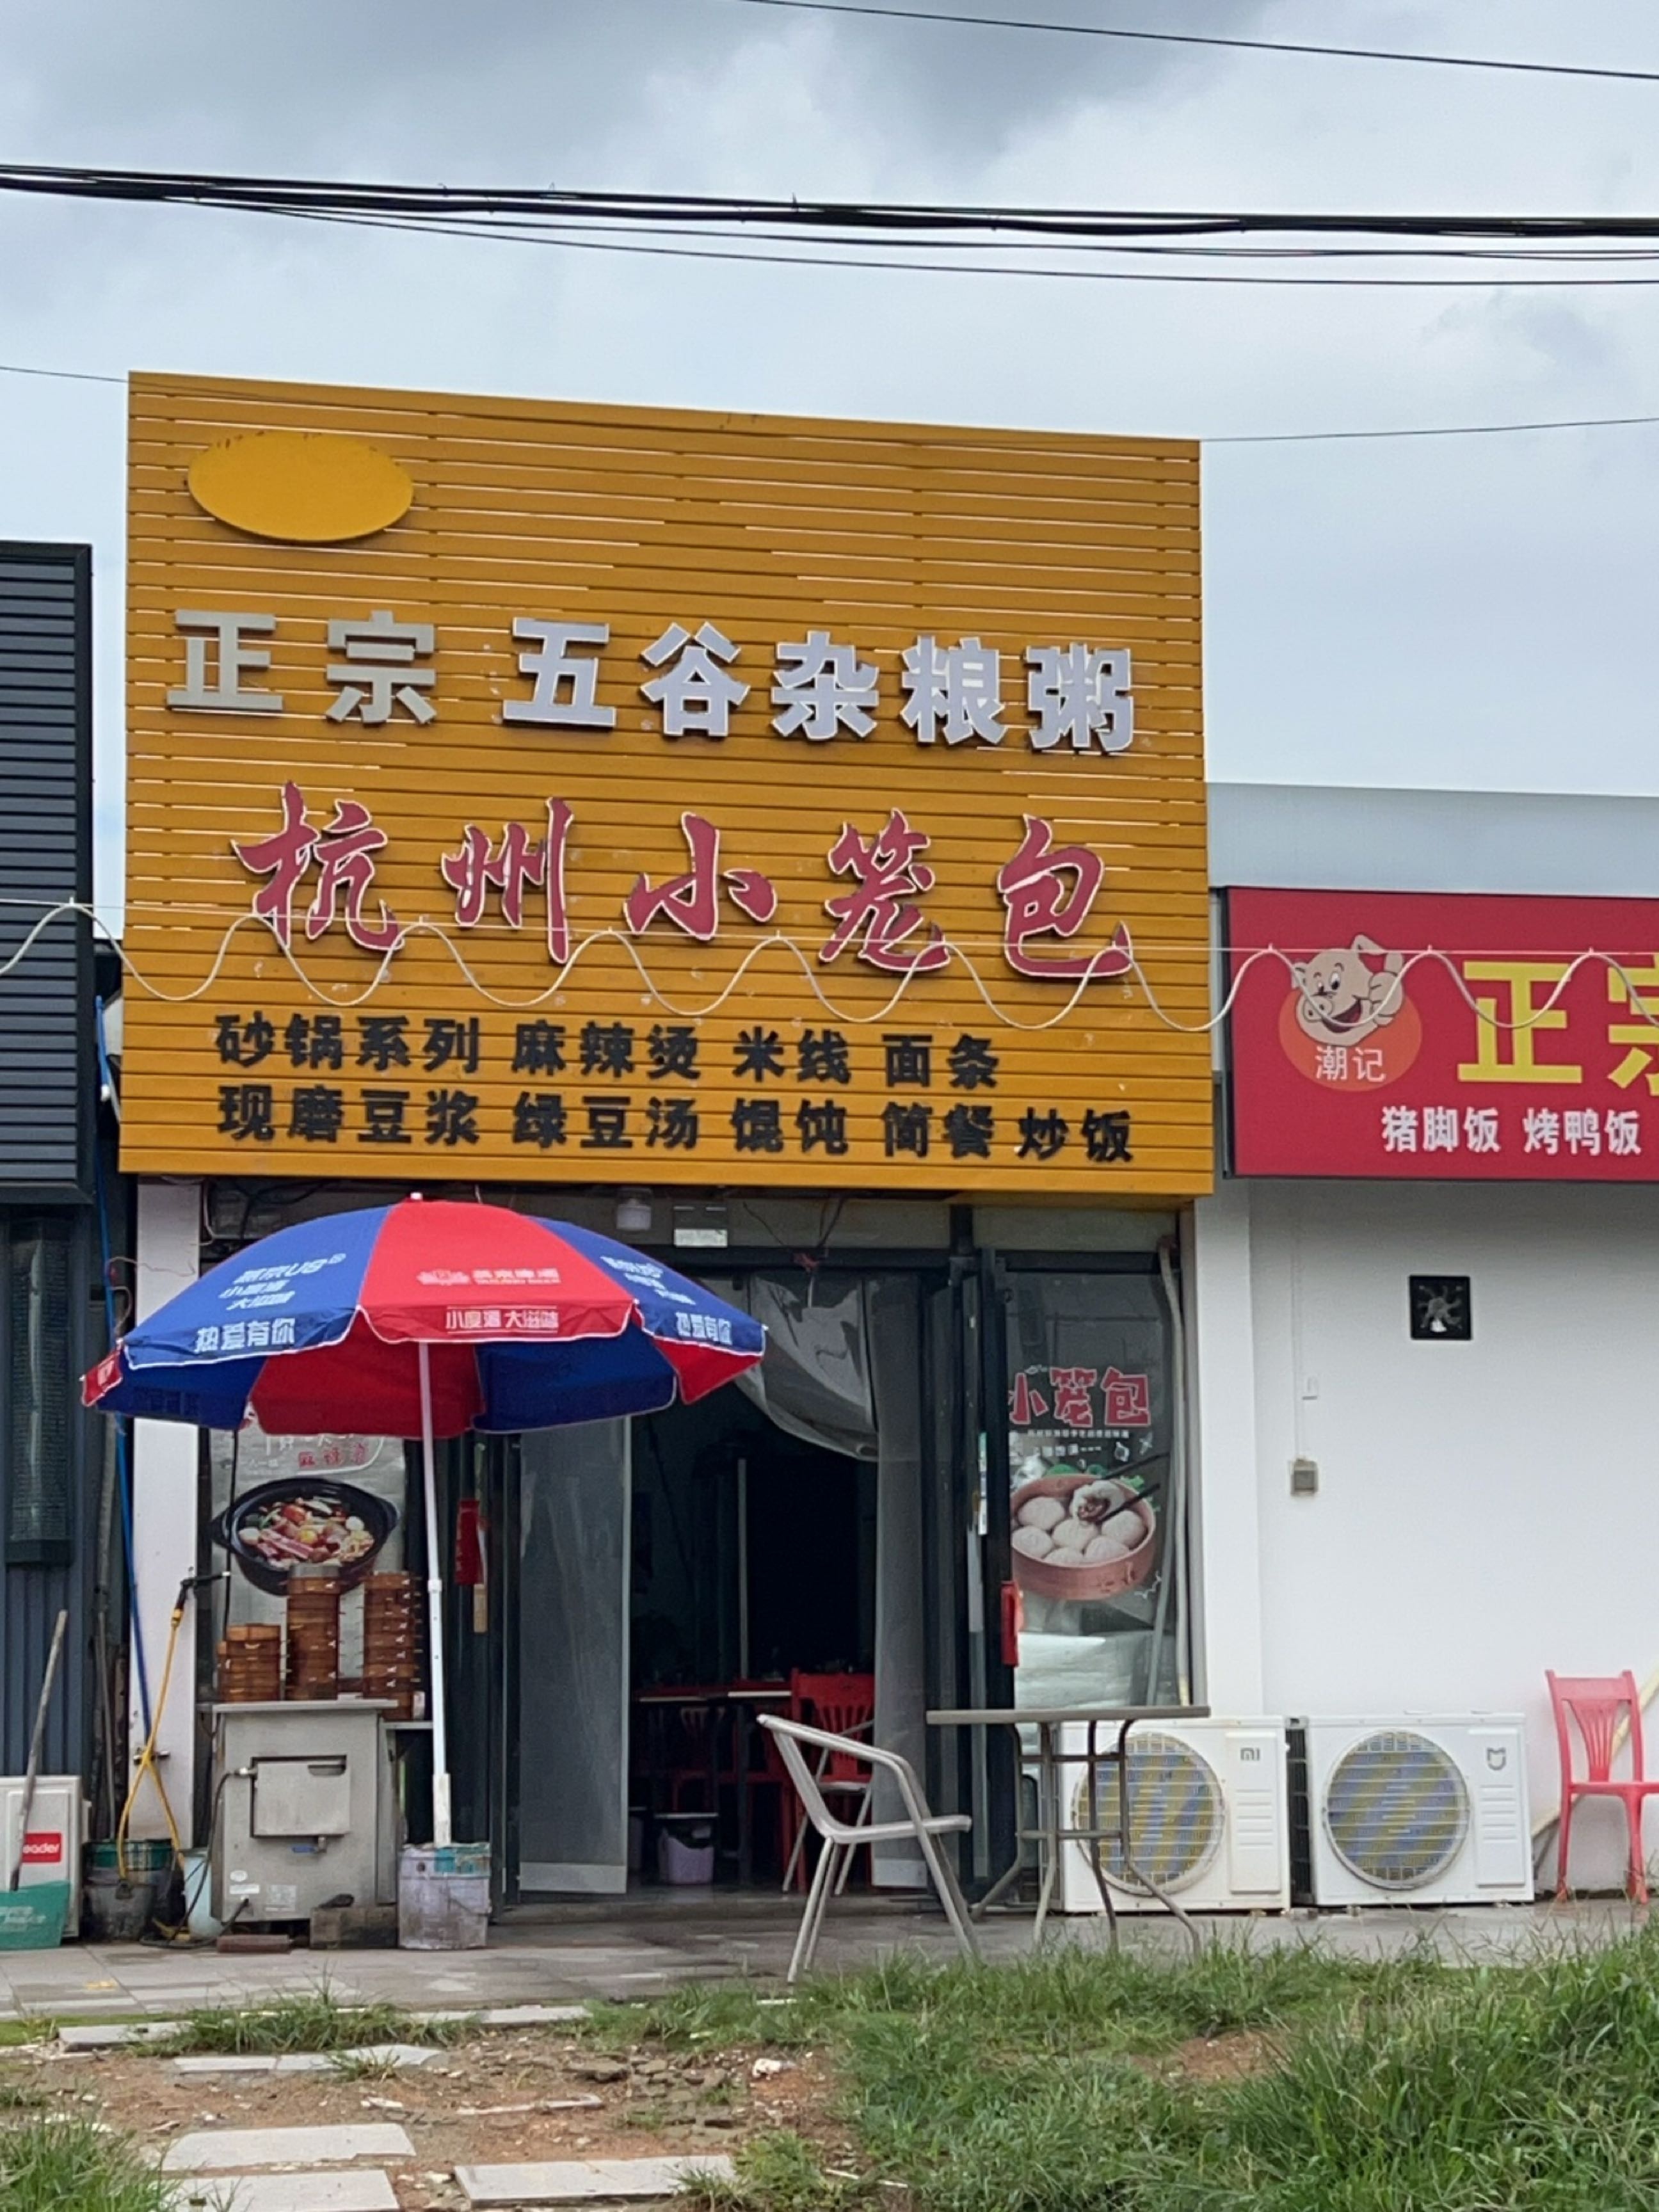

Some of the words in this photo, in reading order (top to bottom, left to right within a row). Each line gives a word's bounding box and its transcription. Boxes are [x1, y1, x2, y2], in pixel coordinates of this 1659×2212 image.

[166, 609, 437, 723] 正宗
[502, 616, 1135, 751] 五谷杂粮粥
[231, 780, 1133, 978] 杭州小笼包
[215, 1011, 480, 1074] 砂锅系列
[511, 1020, 701, 1081] 麻辣烫
[732, 1026, 851, 1084] 米线
[881, 1034, 999, 1089] 面条
[1315, 1045, 1386, 1082] 潮记
[217, 1084, 481, 1146] 现磨豆浆
[512, 1091, 699, 1150] 绿豆汤
[730, 1098, 849, 1155] 馄饨
[881, 1102, 995, 1159] 简餐
[1017, 1107, 1134, 1163] 炒饭
[1381, 1105, 1502, 1153] 猪脚饭
[1521, 1107, 1642, 1157] 烤鸭饭
[194, 1317, 296, 1355] 热爱有你
[1008, 1365, 1151, 1428] 小笼包
[22, 1843, 61, 1855] eader
